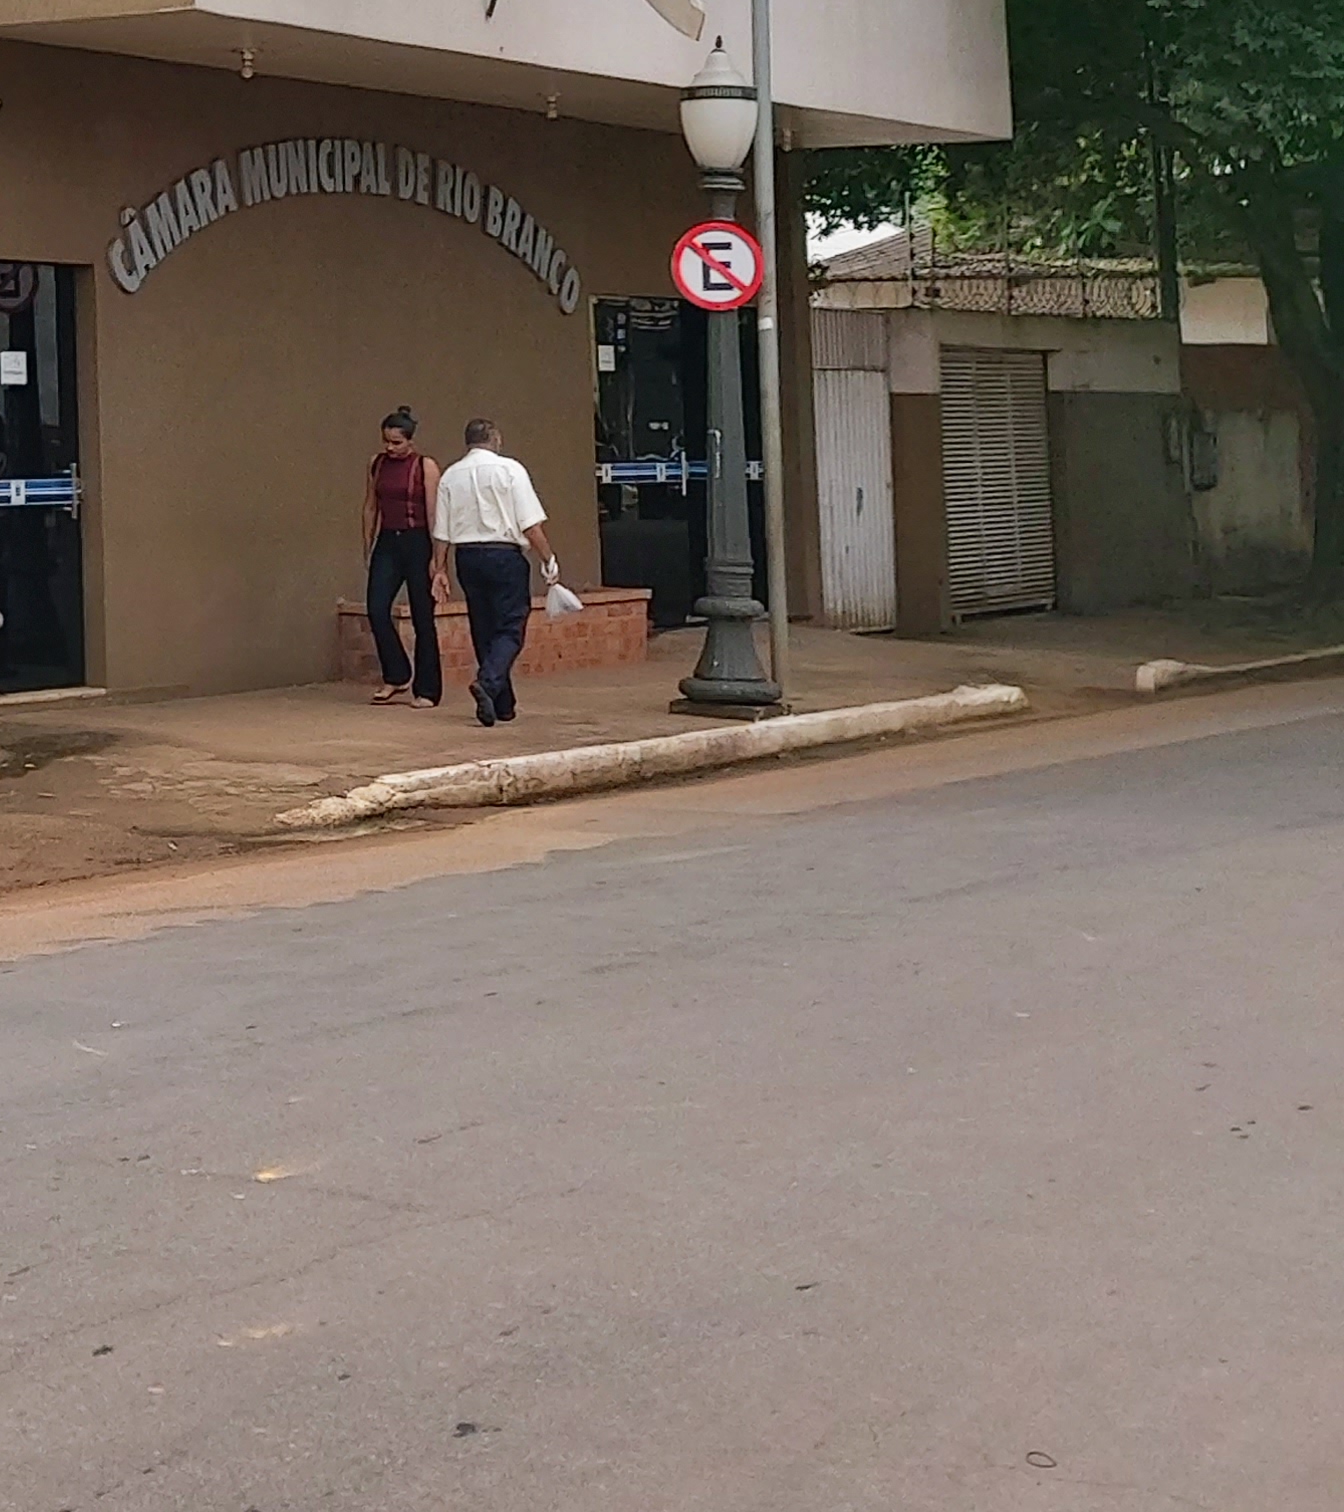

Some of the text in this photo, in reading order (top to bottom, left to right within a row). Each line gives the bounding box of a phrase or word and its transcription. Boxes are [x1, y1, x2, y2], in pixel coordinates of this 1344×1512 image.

[237, 138, 391, 206] MUNICIPAL
[395, 143, 432, 204] DE
[434, 159, 481, 223] RIO
[485, 185, 582, 314] BRANCO
[702, 242, 734, 291] E
